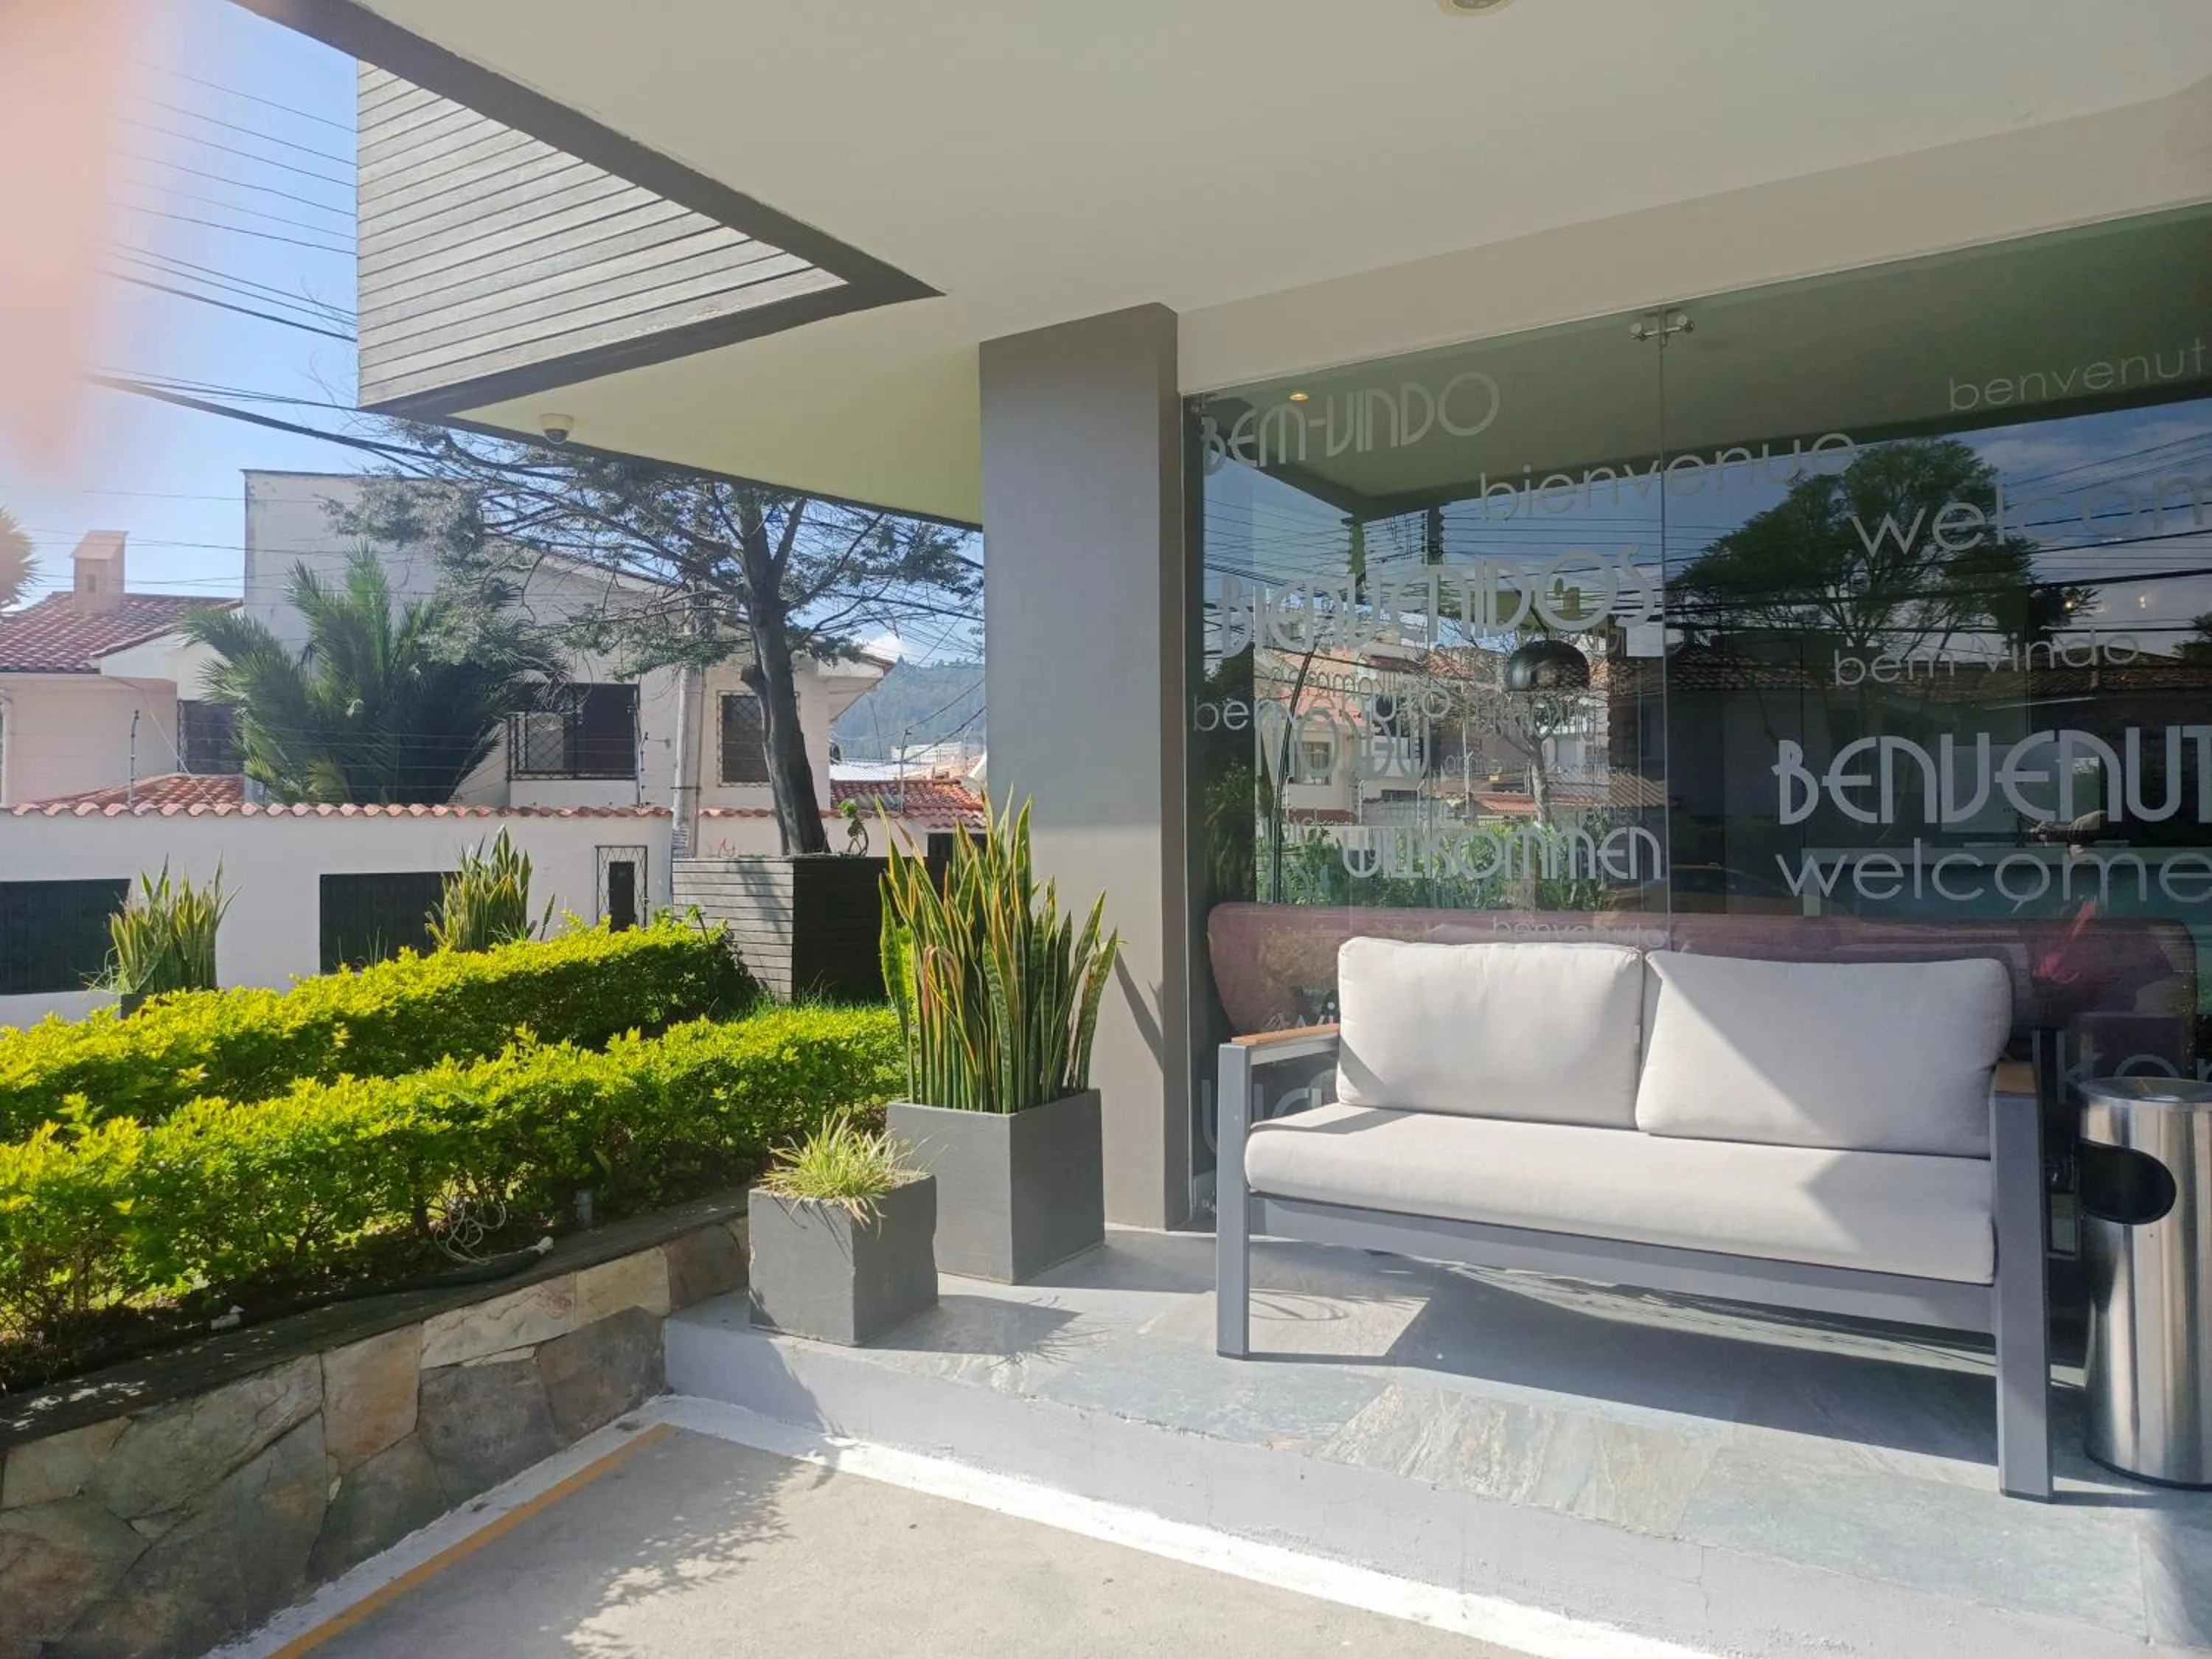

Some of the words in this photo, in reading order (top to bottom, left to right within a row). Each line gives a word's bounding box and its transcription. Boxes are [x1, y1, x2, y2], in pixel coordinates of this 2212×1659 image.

[1480, 432, 1855, 521] bienvenue
[1834, 648, 1955, 686] bem
[1342, 827, 1662, 880] WILLKOMMEN
[1775, 837, 2212, 904] welcome
